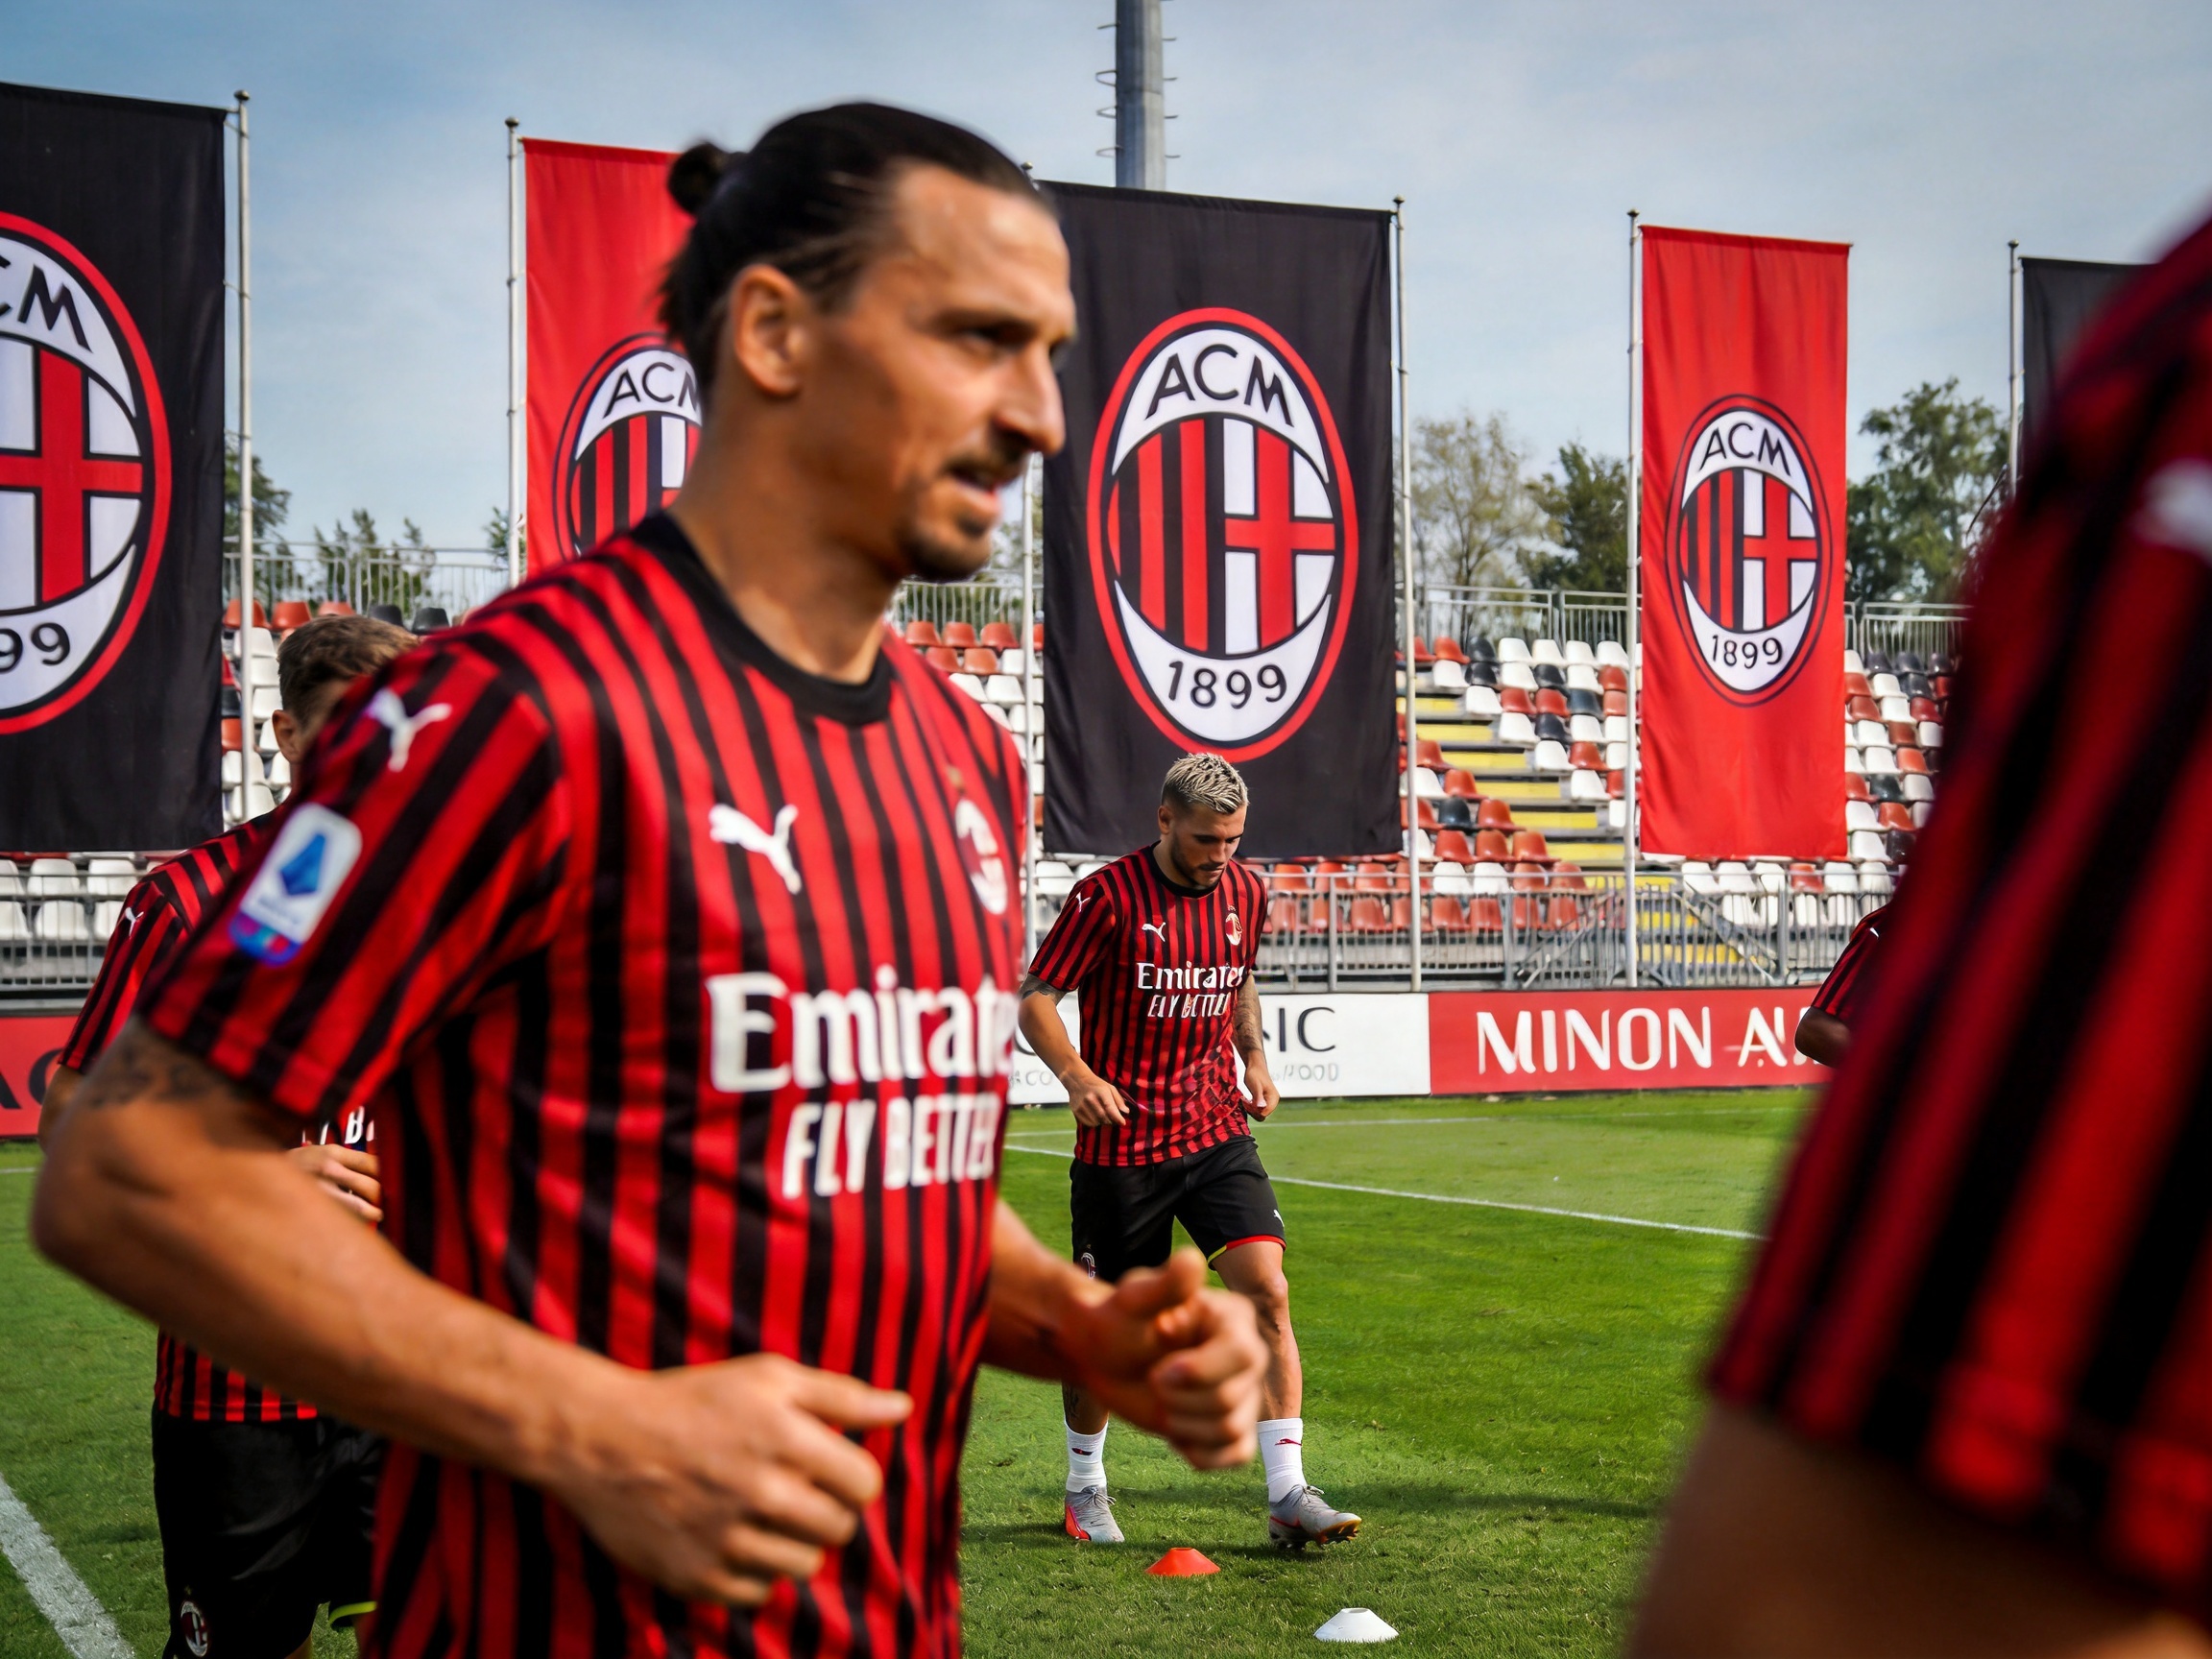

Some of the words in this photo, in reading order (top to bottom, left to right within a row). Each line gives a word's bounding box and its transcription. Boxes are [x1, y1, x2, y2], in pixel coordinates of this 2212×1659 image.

[1144, 344, 1294, 428] ACM
[1699, 422, 1791, 476] ACM
[1712, 635, 1783, 669] 1899
[1168, 661, 1286, 709] 1899
[1477, 1006, 1713, 1074] MINON
[781, 1098, 877, 1199] FLY
